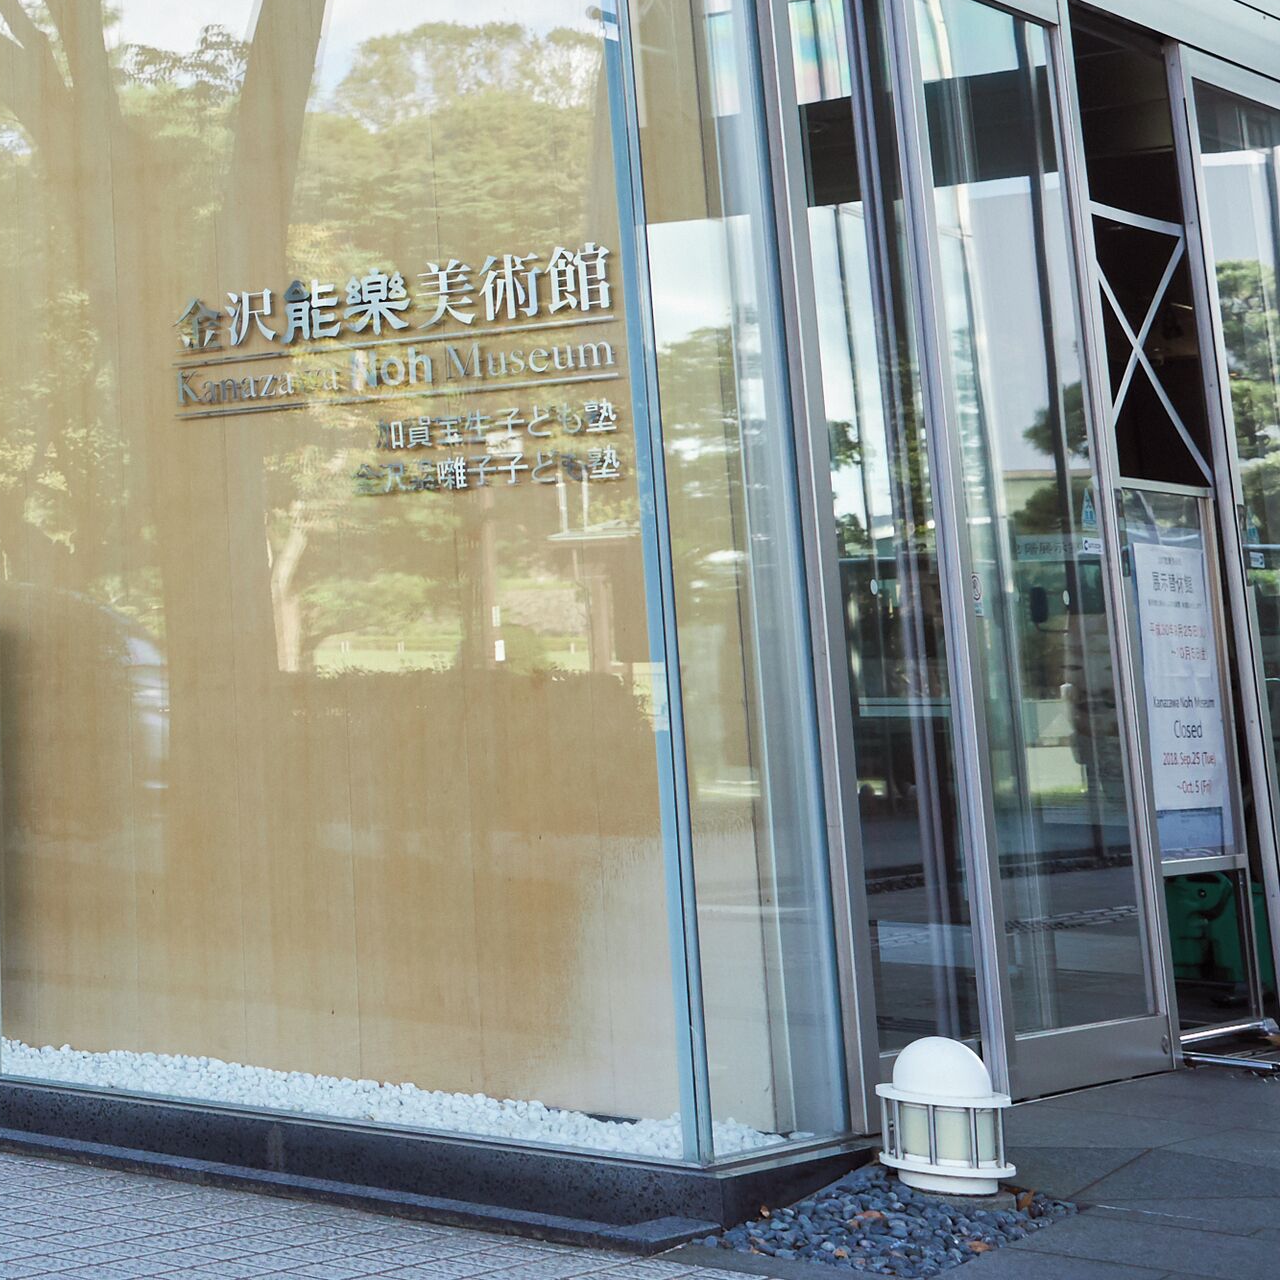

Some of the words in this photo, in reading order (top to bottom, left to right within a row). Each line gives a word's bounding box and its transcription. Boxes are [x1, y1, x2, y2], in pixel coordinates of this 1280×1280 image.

[350, 346, 433, 391] Noh
[445, 339, 616, 381] Museum
[1180, 695, 1193, 709] Noh
[1173, 720, 1203, 739] Closed
